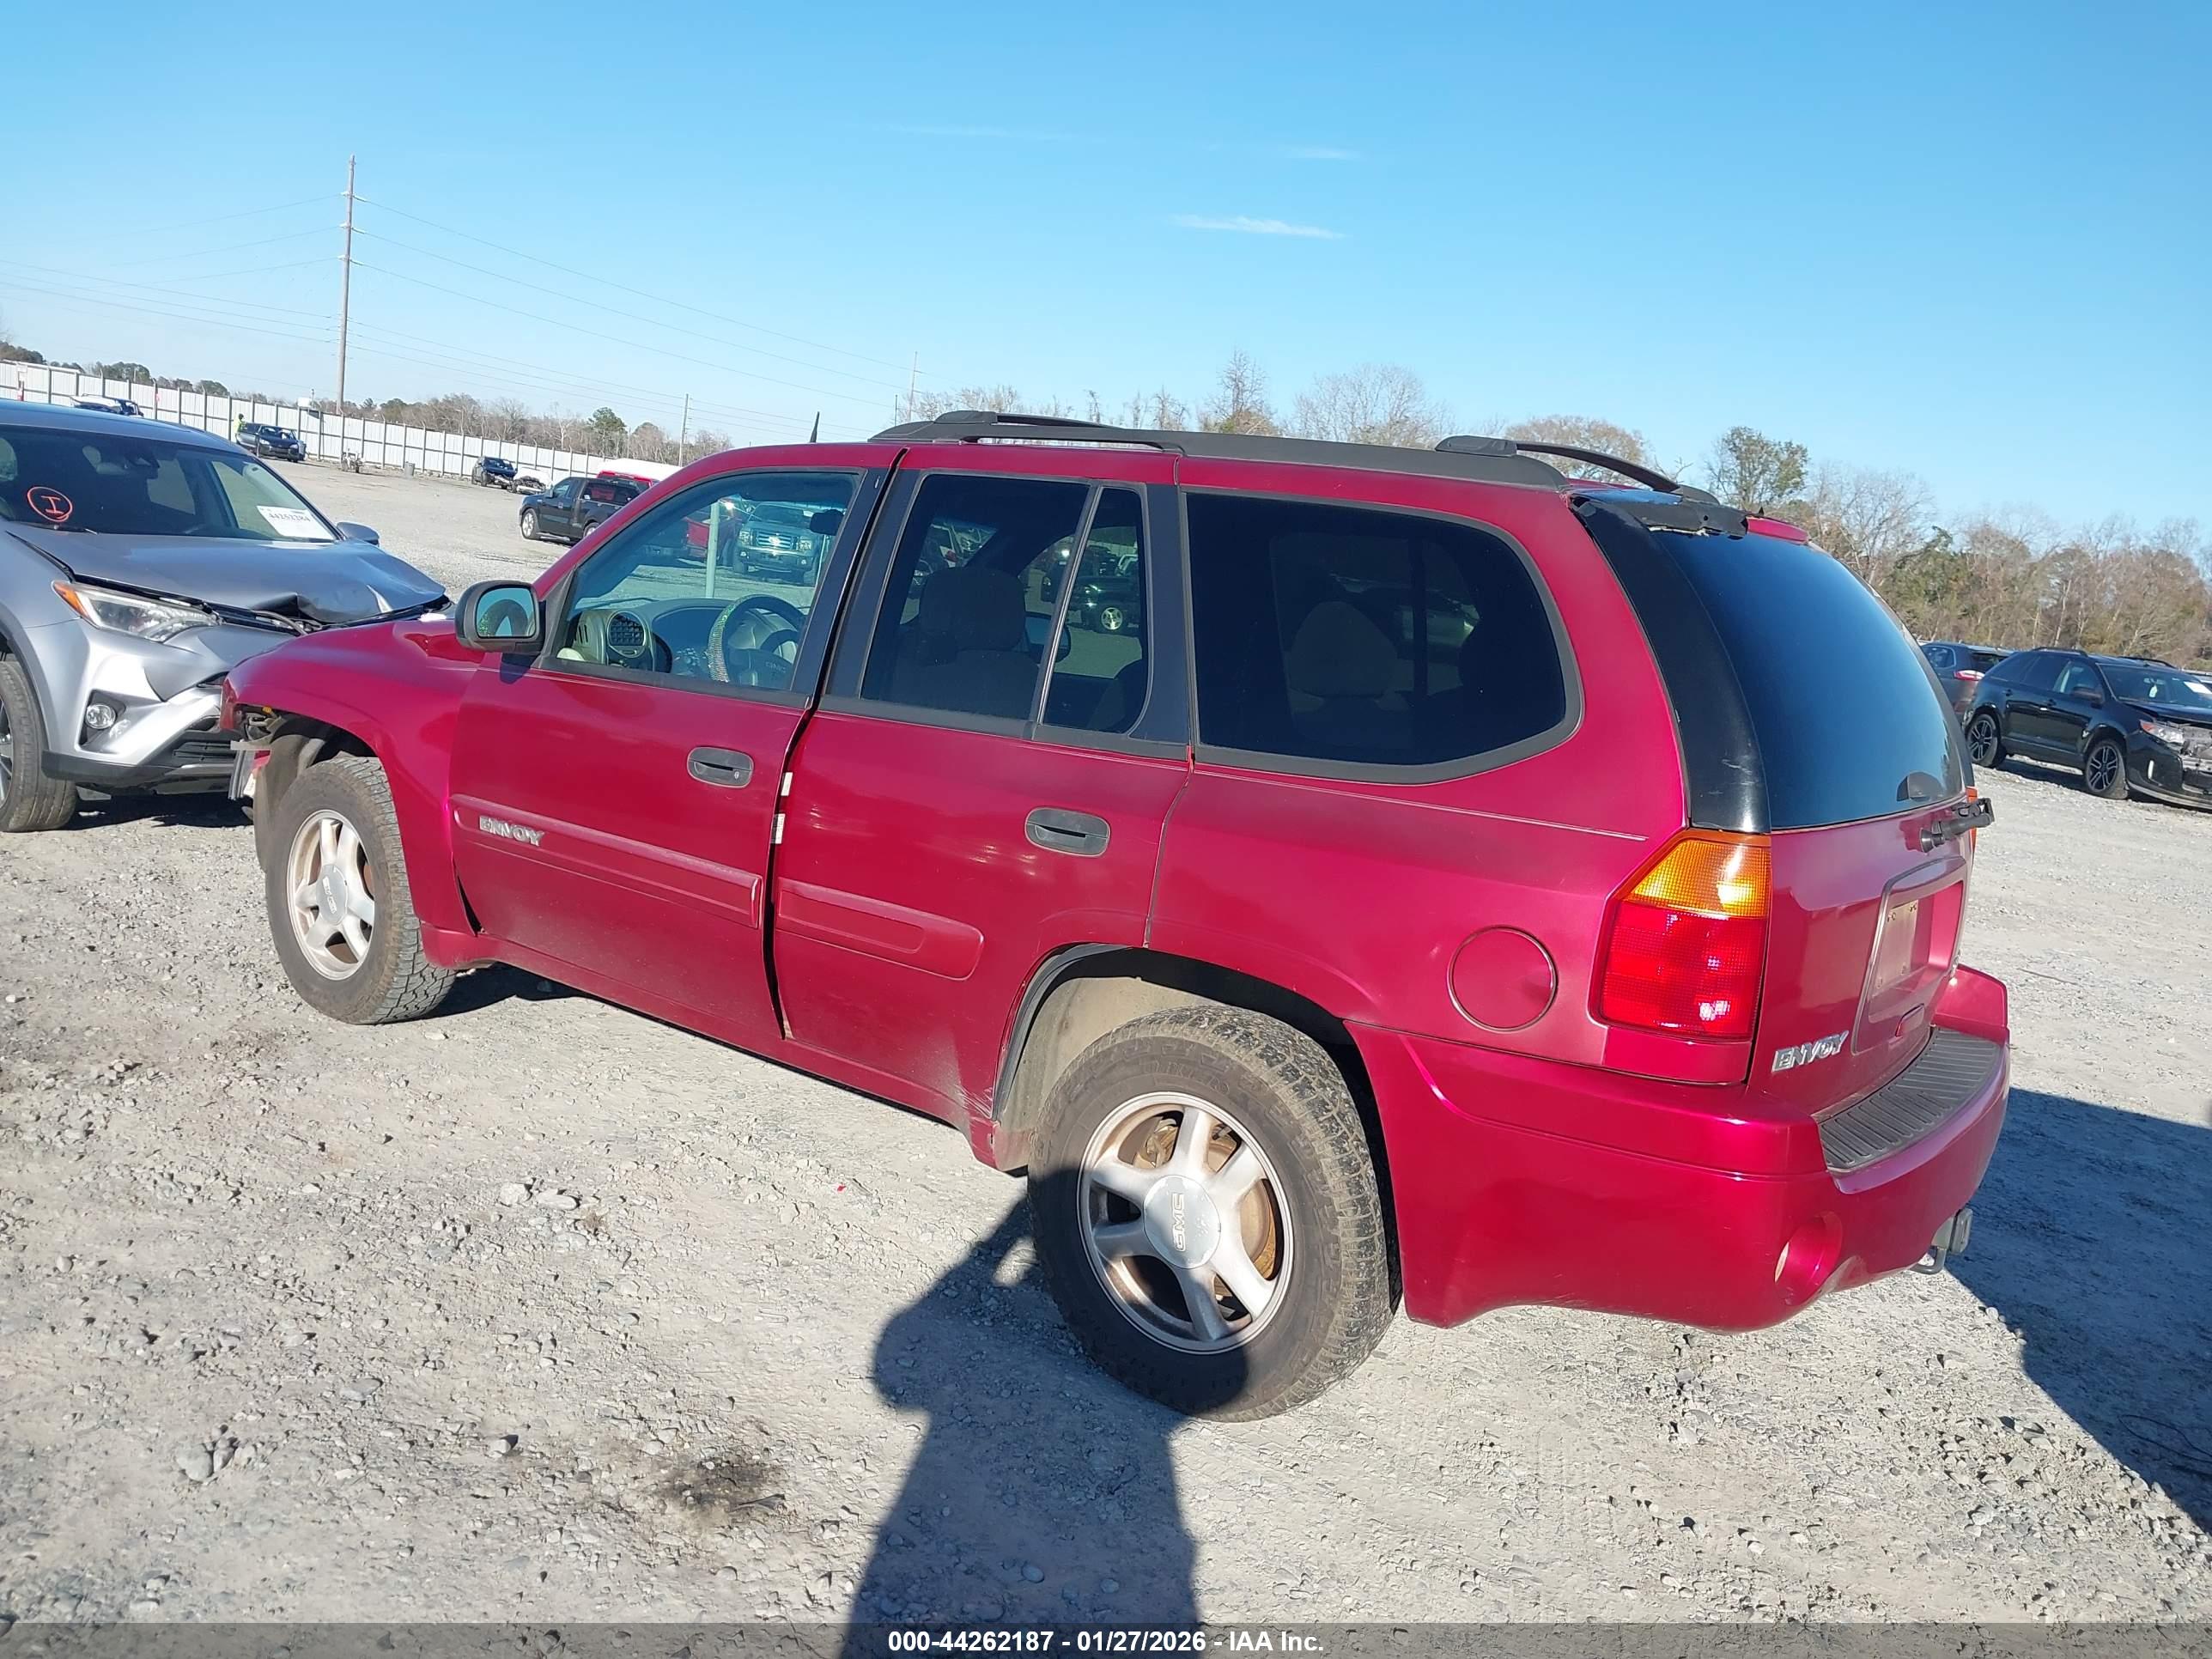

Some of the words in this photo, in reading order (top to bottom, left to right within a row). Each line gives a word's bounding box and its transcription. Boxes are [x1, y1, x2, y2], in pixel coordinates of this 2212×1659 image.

[479, 815, 544, 847] ENVOY
[1771, 1030, 1849, 1073] ENVOY
[1171, 1192, 1186, 1252] GMC
